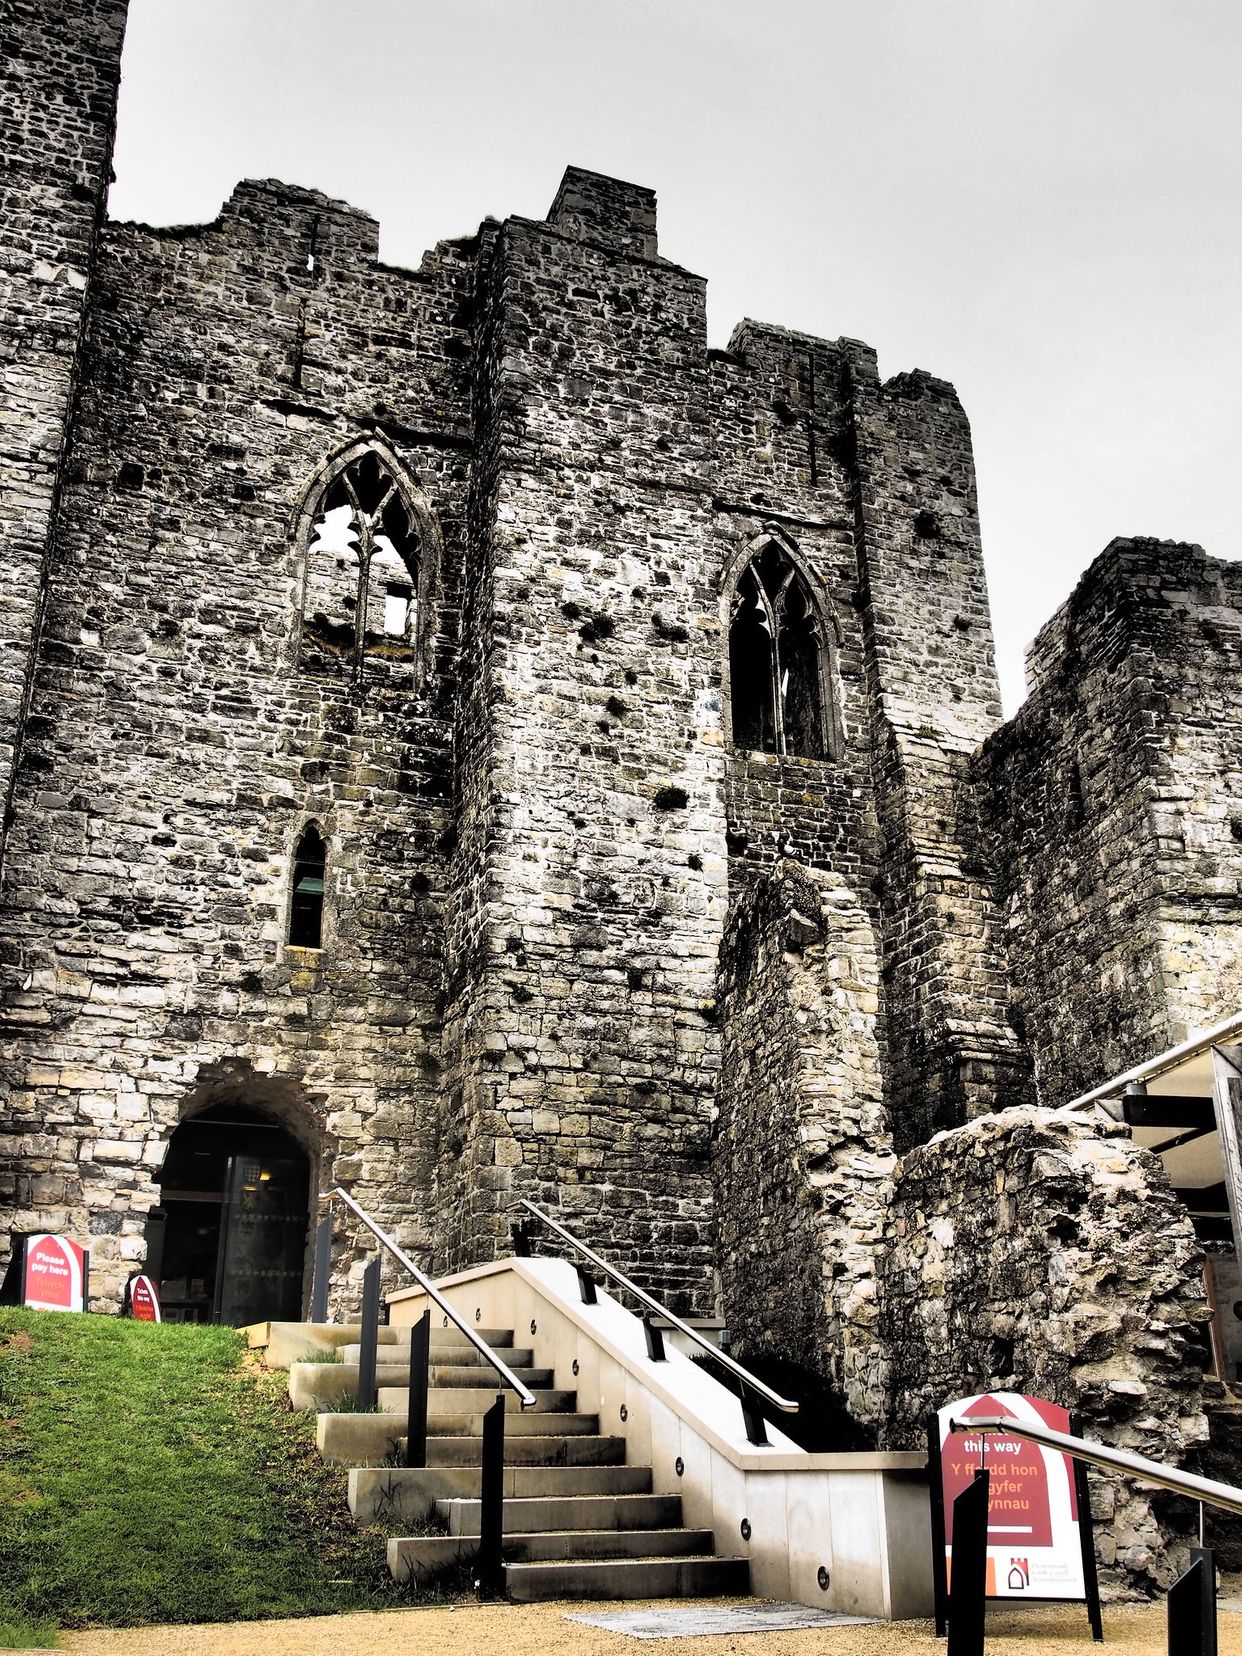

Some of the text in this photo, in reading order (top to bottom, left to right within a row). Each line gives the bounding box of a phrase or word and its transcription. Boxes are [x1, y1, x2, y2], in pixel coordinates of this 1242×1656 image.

[36, 1252, 64, 1265] Please
[32, 1264, 68, 1276] pay here
[964, 1440, 1022, 1455] this way
[951, 1463, 1038, 1475] Y ffdd hon
[988, 1480, 1023, 1495] gyfer
